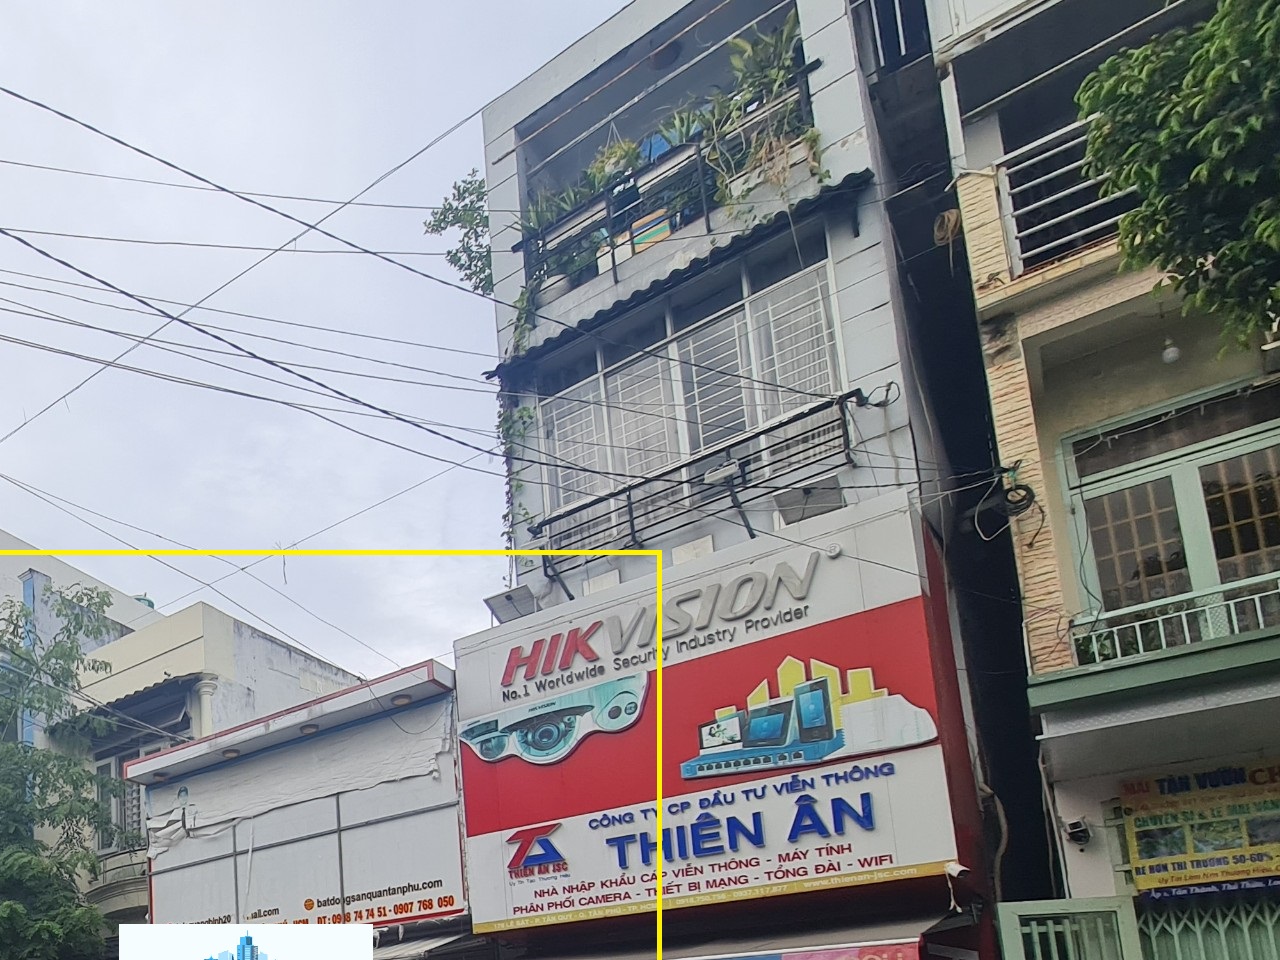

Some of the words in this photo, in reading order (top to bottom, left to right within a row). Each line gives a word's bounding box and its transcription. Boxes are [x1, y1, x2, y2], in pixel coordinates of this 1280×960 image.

[501, 551, 820, 687] HIKVISION
[502, 684, 530, 702] No.1
[535, 663, 606, 691] Worldwide
[612, 643, 670, 672] Securiy
[675, 624, 737, 653] Industry
[744, 604, 811, 633] Provider
[588, 813, 636, 830] CÔNG
[667, 799, 691, 816] CP
[699, 788, 738, 812] ĐẦU
[741, 783, 768, 803] TƯ
[772, 773, 816, 798] VIỄN
[820, 761, 896, 790] THÔNG
[605, 810, 766, 869] THIÊN
[787, 791, 877, 843] ÂN
[512, 902, 545, 916] PHÂN
[547, 895, 575, 911] PHỐI
[578, 891, 632, 908] CAMERA
[687, 881, 701, 893] BỊ
[705, 875, 749, 893] MẠNG
[764, 864, 809, 882] TỔNG
[814, 858, 841, 875] ĐÀI
[857, 853, 895, 869] WIFI
[534, 885, 559, 899] NHÀ
[562, 881, 596, 895] NHẬP
[600, 871, 636, 890] KHẨU
[672, 862, 704, 879] VIỄN
[708, 856, 761, 875] THÔNG
[777, 848, 810, 864] MÁY
[815, 842, 853, 858] TÍNH
[551, 861, 569, 873] JSC
[802, 866, 918, 889] www.thienan-jsc.com
[331, 912, 352, 924] 098
[353, 909, 363, 923] 74
[365, 907, 375, 919] 74
[377, 905, 388, 917] 51
[393, 902, 414, 916] 0907
[417, 898, 434, 912] 768
[437, 894, 455, 908] 050
